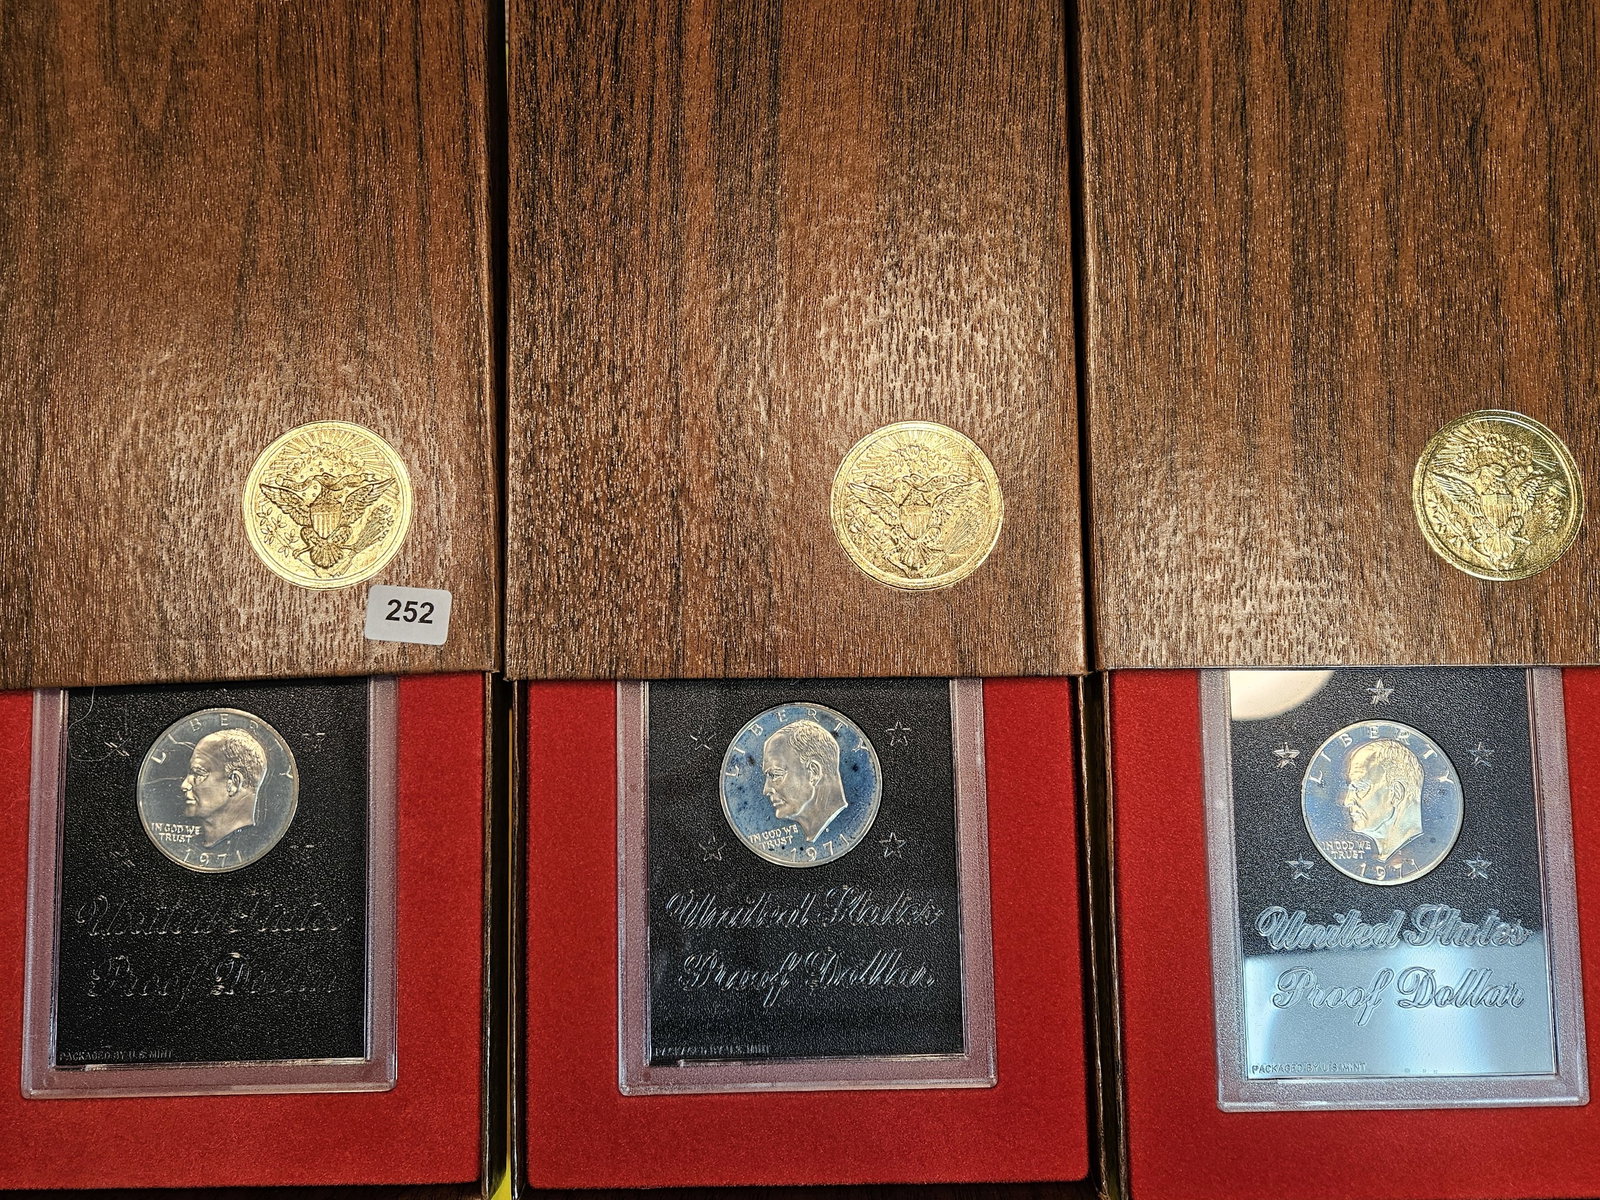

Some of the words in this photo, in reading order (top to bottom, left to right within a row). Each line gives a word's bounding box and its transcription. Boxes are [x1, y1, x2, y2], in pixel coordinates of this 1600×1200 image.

[385, 598, 435, 625] 252
[725, 707, 869, 779] LIBERTY
[1308, 726, 1455, 785] LIBERTY
[151, 822, 163, 832] IN
[164, 823, 184, 834] GOD
[185, 825, 202, 835] WE
[158, 832, 193, 844] TRUST
[748, 833, 761, 844] IN
[762, 829, 782, 840] GOD
[782, 823, 799, 836] WE
[758, 834, 794, 850] TRUST
[790, 833, 850, 863] 1971
[1321, 840, 1333, 851] IN
[1355, 840, 1372, 851] WE
[184, 848, 243, 868] 1971
[1330, 850, 1366, 860] TRUST
[665, 888, 815, 929] United
[816, 884, 944, 929] States
[1255, 904, 1405, 950] United
[1403, 903, 1534, 948] States
[677, 948, 802, 1008] Proof
[803, 946, 936, 991] Dollar
[1272, 965, 1395, 1027] Proof
[1395, 965, 1526, 1009] Dollar
[1251, 1063, 1303, 1074] PACKAGED
[1306, 1063, 1320, 1073] BY
[1341, 1062, 1366, 1073] MINT
